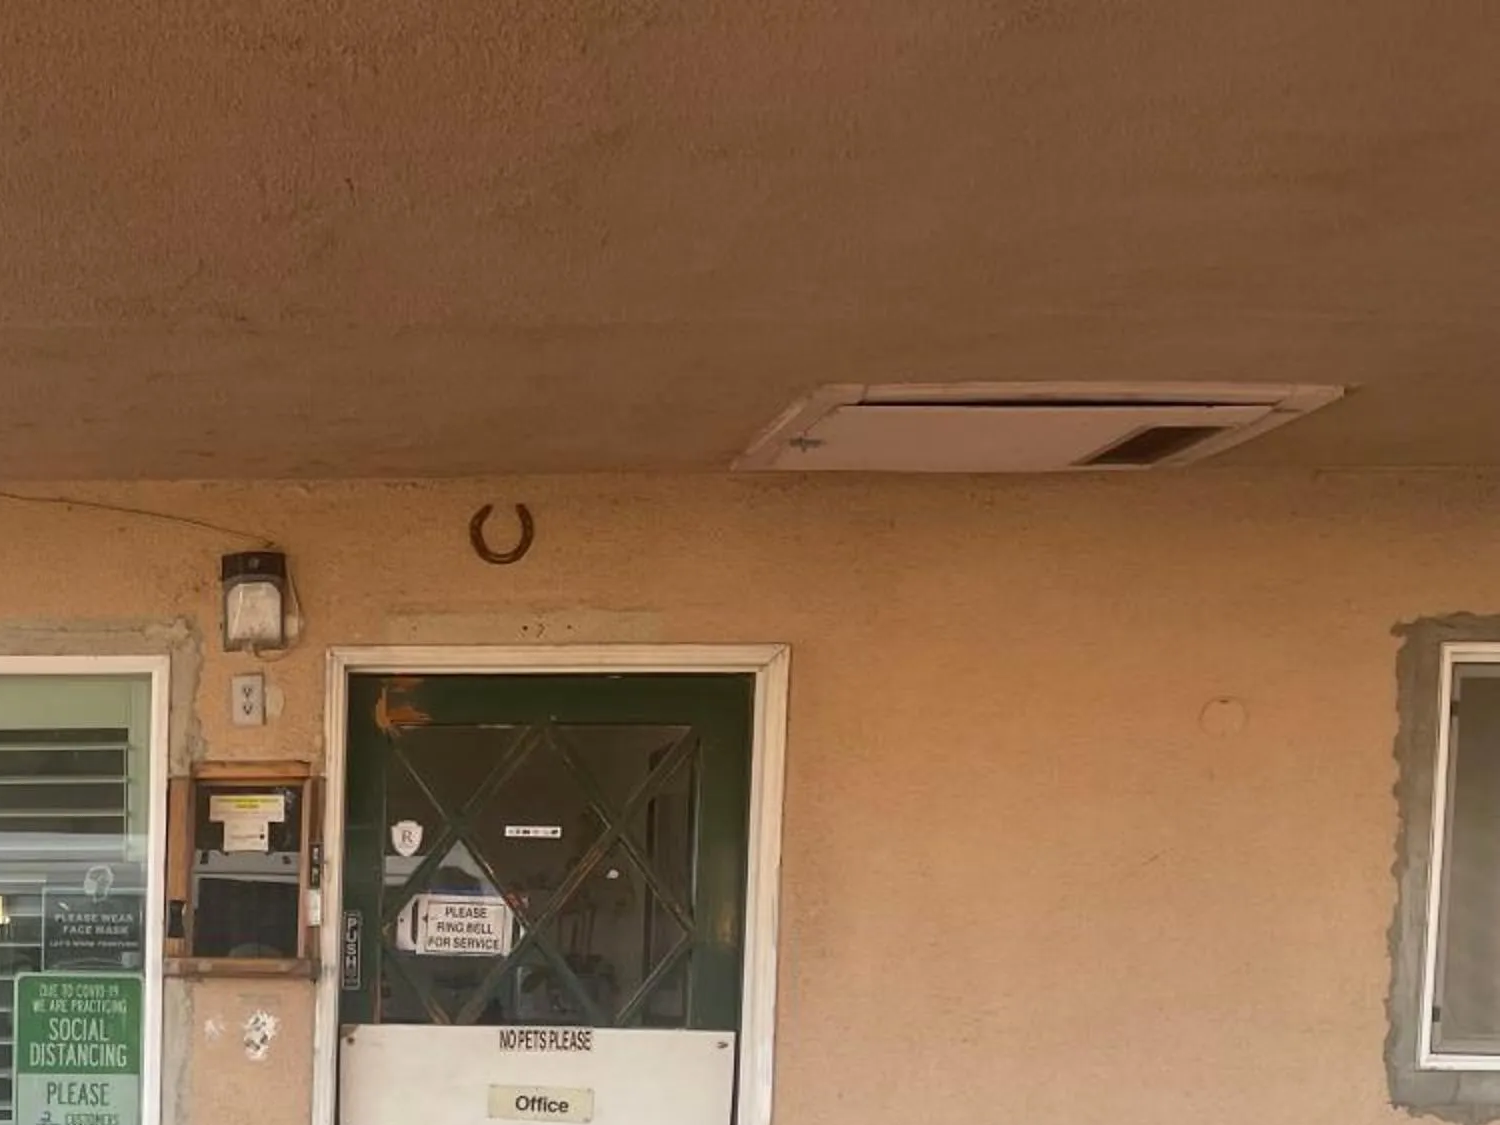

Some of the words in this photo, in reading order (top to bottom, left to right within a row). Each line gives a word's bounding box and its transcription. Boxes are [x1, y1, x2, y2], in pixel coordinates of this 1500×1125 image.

[446, 906, 488, 918] PLEASE
[63, 925, 92, 934] FACE
[95, 926, 129, 934] MASK
[437, 922, 464, 932] RING
[467, 922, 493, 934] BELL
[427, 936, 451, 948] FOR
[453, 938, 500, 950] SERVICE
[39, 983, 59, 997] DUE
[32, 1000, 46, 1013] WE
[49, 999, 68, 1013] ARE
[71, 999, 127, 1014] PRACTICING
[49, 1017, 109, 1041] SOCIAL
[500, 1030, 517, 1049] NO
[518, 1030, 547, 1050] PETS
[549, 1030, 592, 1051] PLEASE
[30, 1042, 127, 1067] DISTANCING
[47, 1082, 110, 1106] PLEASE
[515, 1095, 569, 1113] Office
